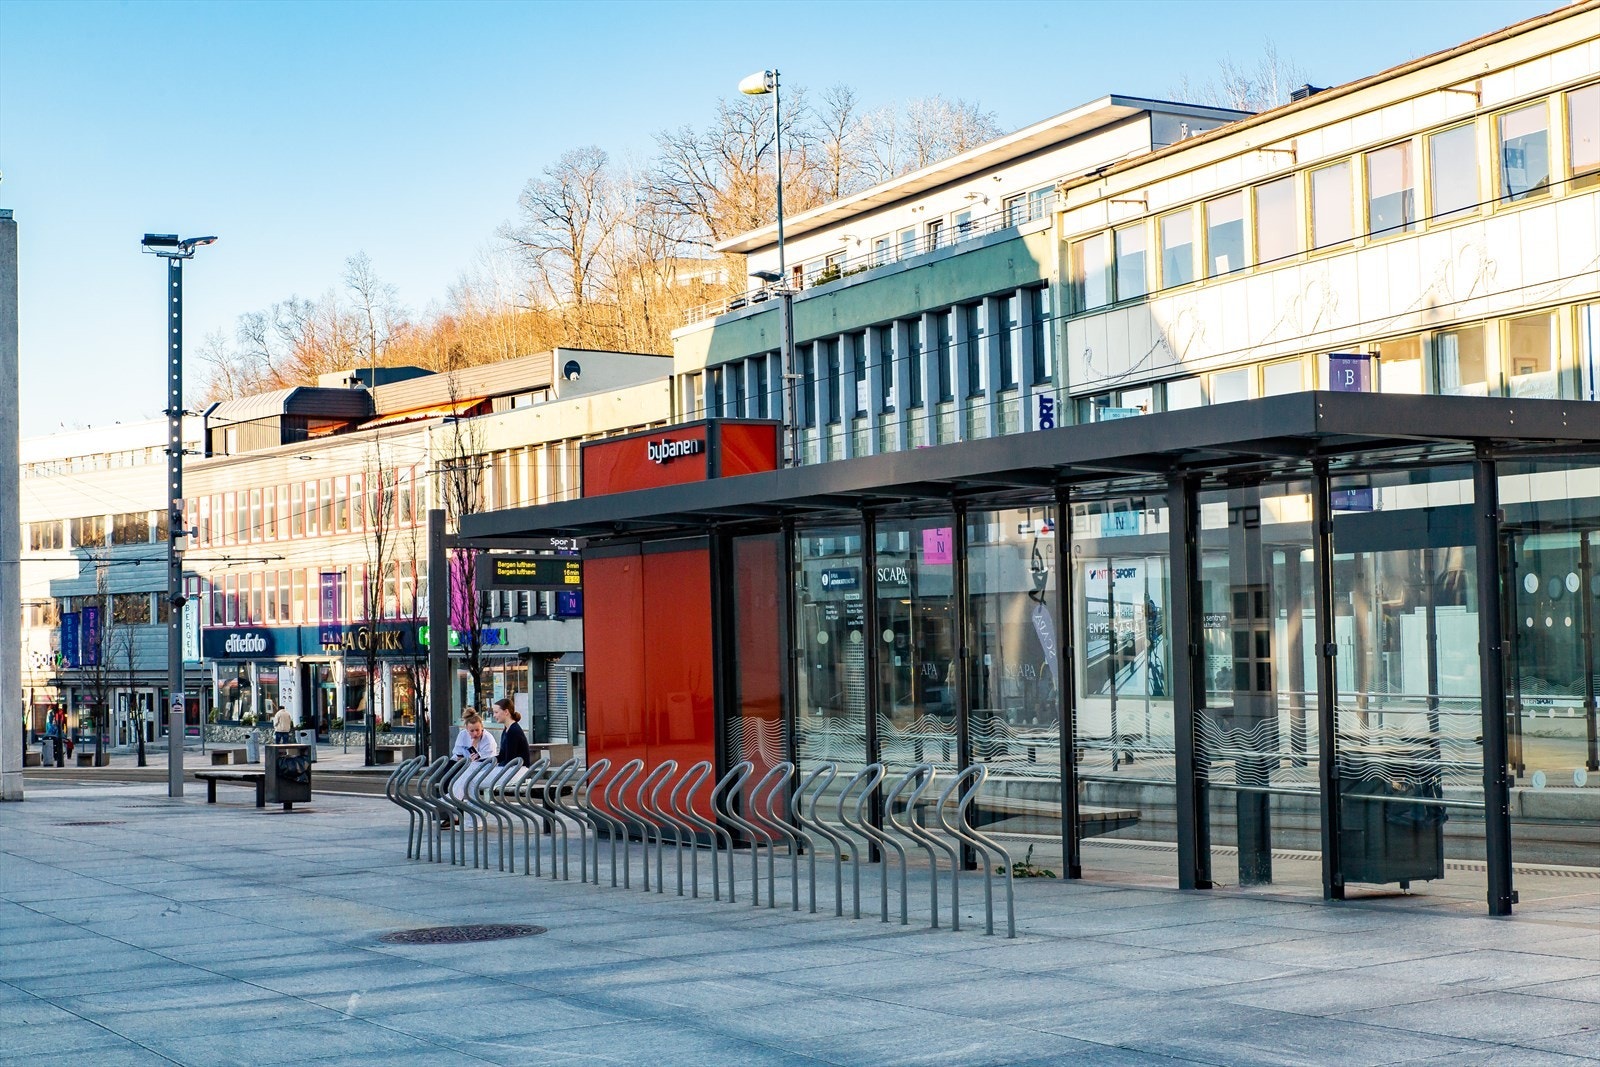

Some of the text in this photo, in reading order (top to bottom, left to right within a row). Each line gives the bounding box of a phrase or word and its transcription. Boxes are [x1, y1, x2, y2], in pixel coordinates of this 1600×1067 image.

[647, 438, 699, 464] bybanen
[550, 537, 579, 550] Spor 1
[877, 567, 907, 582] SCAPA
[1096, 567, 1137, 580] INTRSPORT
[185, 604, 193, 657] BERGEN
[1100, 622, 1118, 633] PES
[225, 632, 267, 653] elitefoto
[920, 663, 938, 676] APA
